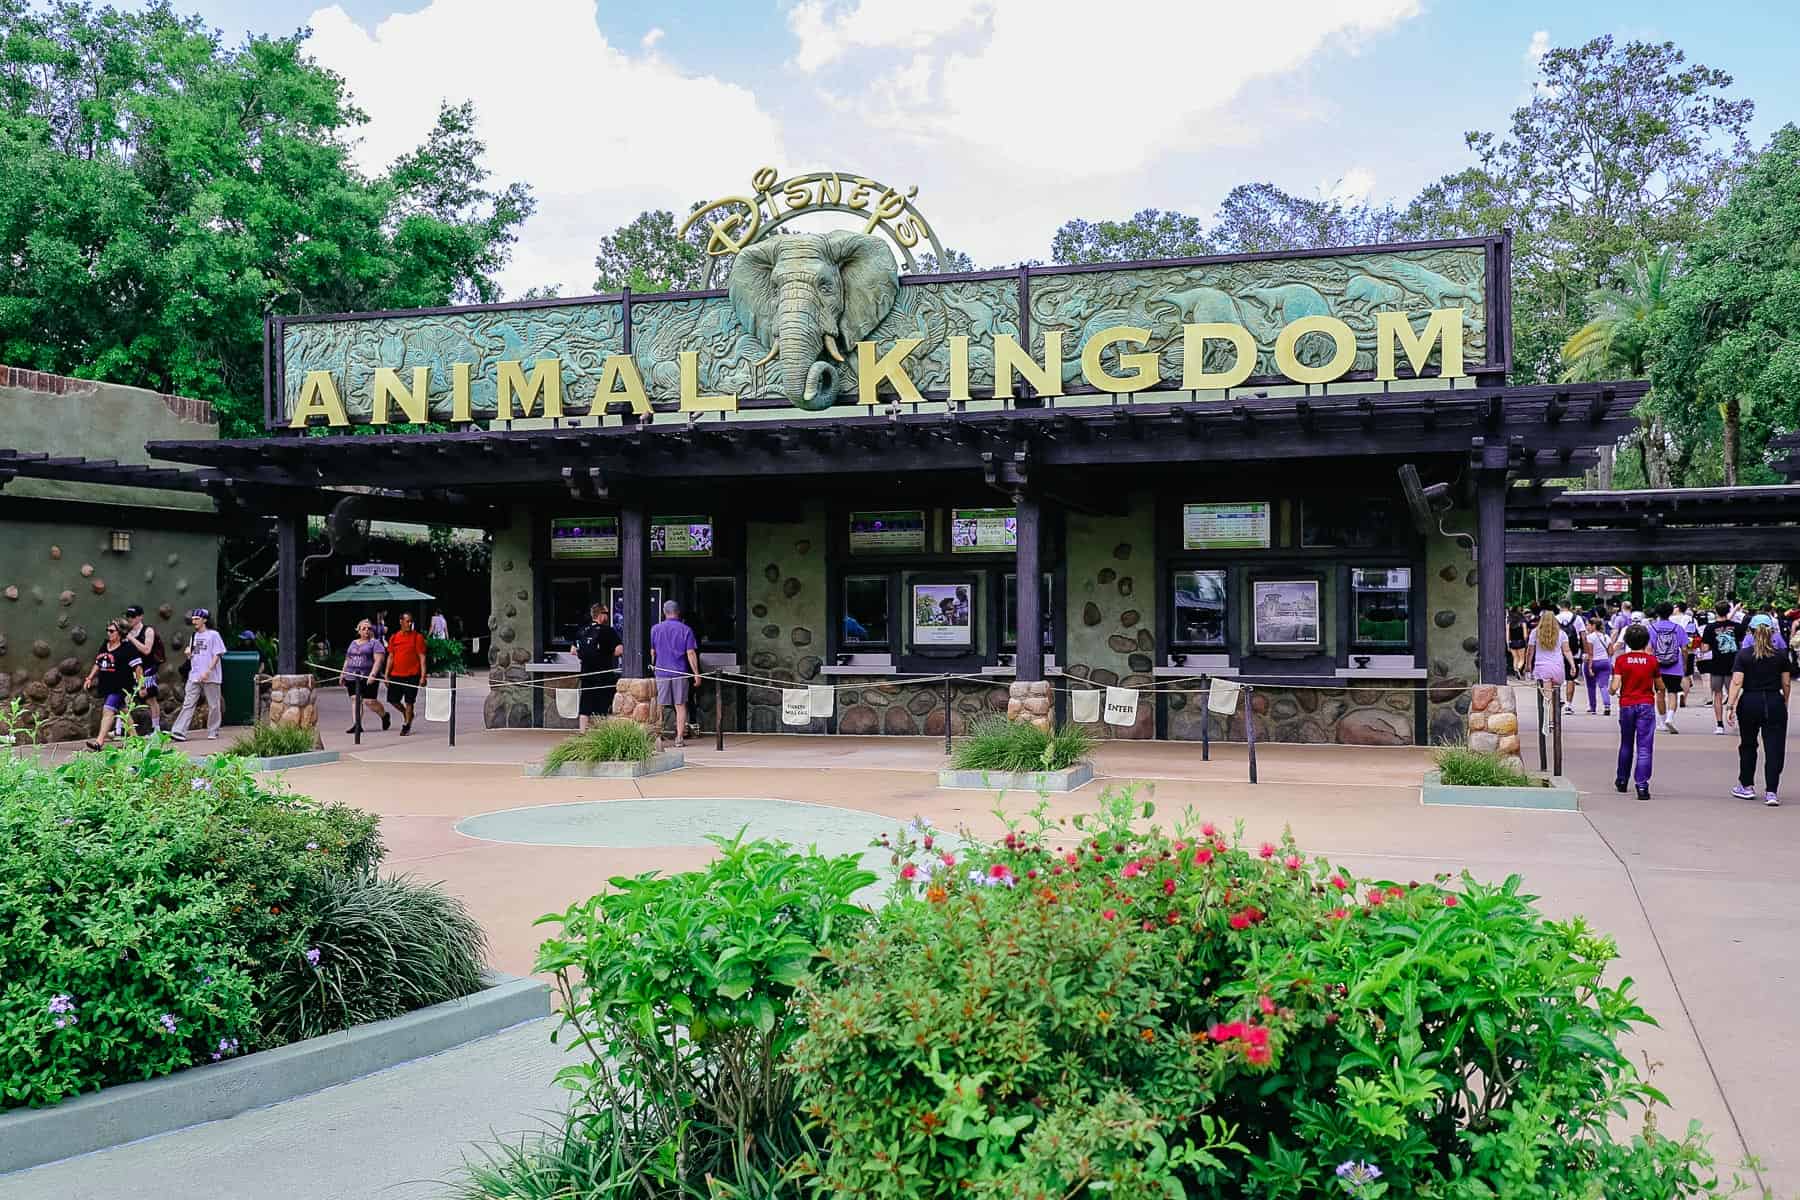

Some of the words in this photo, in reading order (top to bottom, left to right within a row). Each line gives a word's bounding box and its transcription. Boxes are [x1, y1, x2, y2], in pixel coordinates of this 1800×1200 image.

[288, 350, 739, 430] ANIMAL
[855, 306, 1468, 406] KINGDOM
[1108, 703, 1134, 713] ENTER
